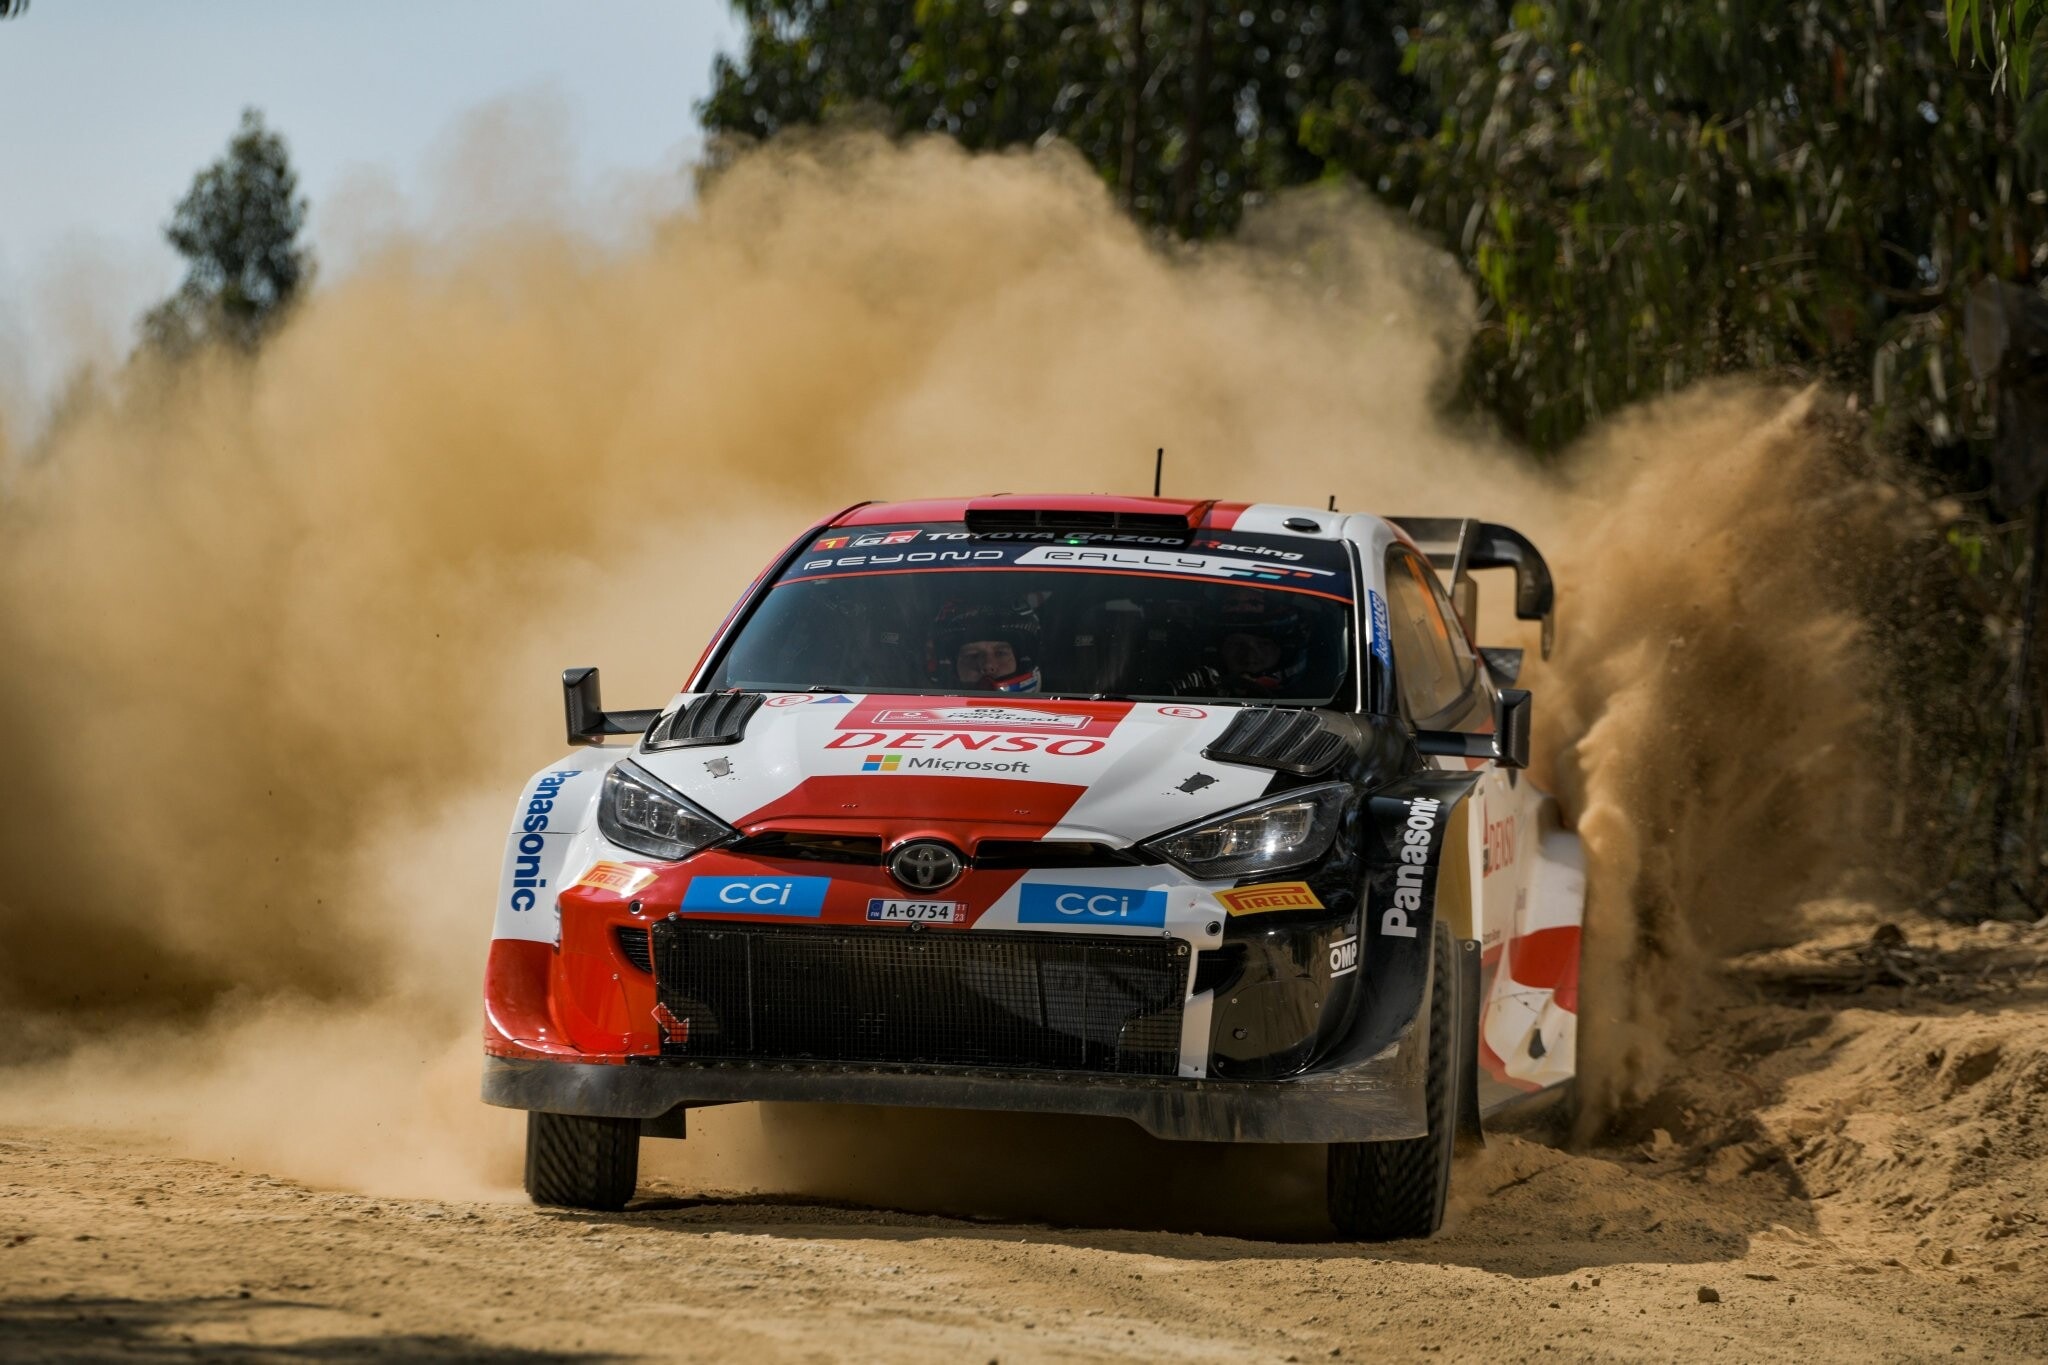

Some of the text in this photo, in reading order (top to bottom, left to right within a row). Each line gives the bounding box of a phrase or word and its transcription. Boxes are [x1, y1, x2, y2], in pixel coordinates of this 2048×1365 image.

[855, 532, 1304, 561] GR TOYOTA GAZOO Racing
[804, 550, 1207, 570] BEYOND RALLY
[824, 732, 1106, 756] DENSO
[908, 757, 1031, 774] Microsoft
[510, 770, 583, 912] Panasonic
[1380, 797, 1441, 938] Panasonic
[1223, 886, 1314, 911] PIRELLI
[886, 903, 949, 919] A-6754
[954, 913, 965, 922] 23
[1330, 942, 1357, 971] OMP
